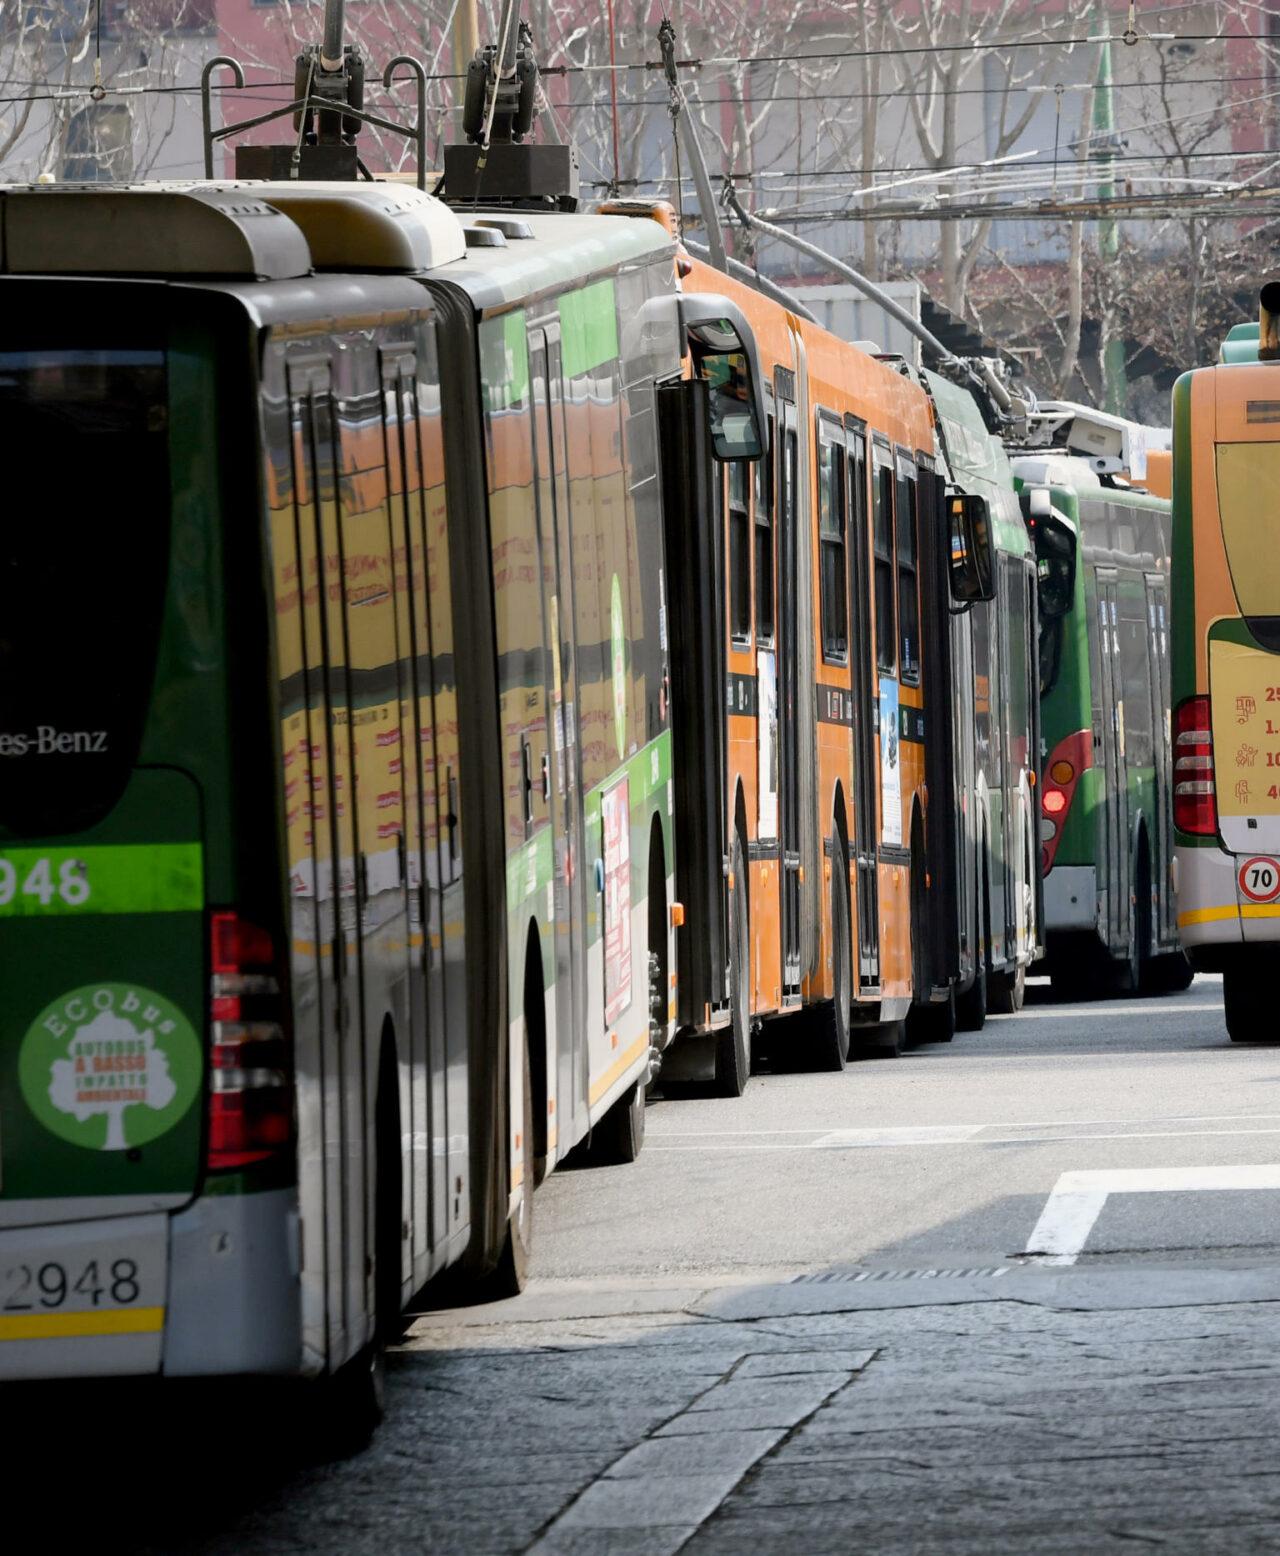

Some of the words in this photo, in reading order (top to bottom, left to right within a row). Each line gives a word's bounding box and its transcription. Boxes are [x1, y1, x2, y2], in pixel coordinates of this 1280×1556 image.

[0, 725, 108, 756] es-Benz
[1251, 869, 1272, 888] 70
[43, 989, 177, 1040] ECObus
[75, 1040, 146, 1056] AUTOBUS
[75, 1056, 86, 1073] A
[93, 1055, 146, 1072] BASSO
[75, 1073, 147, 1088] IMPATTO
[3, 1258, 140, 1311] 2948
